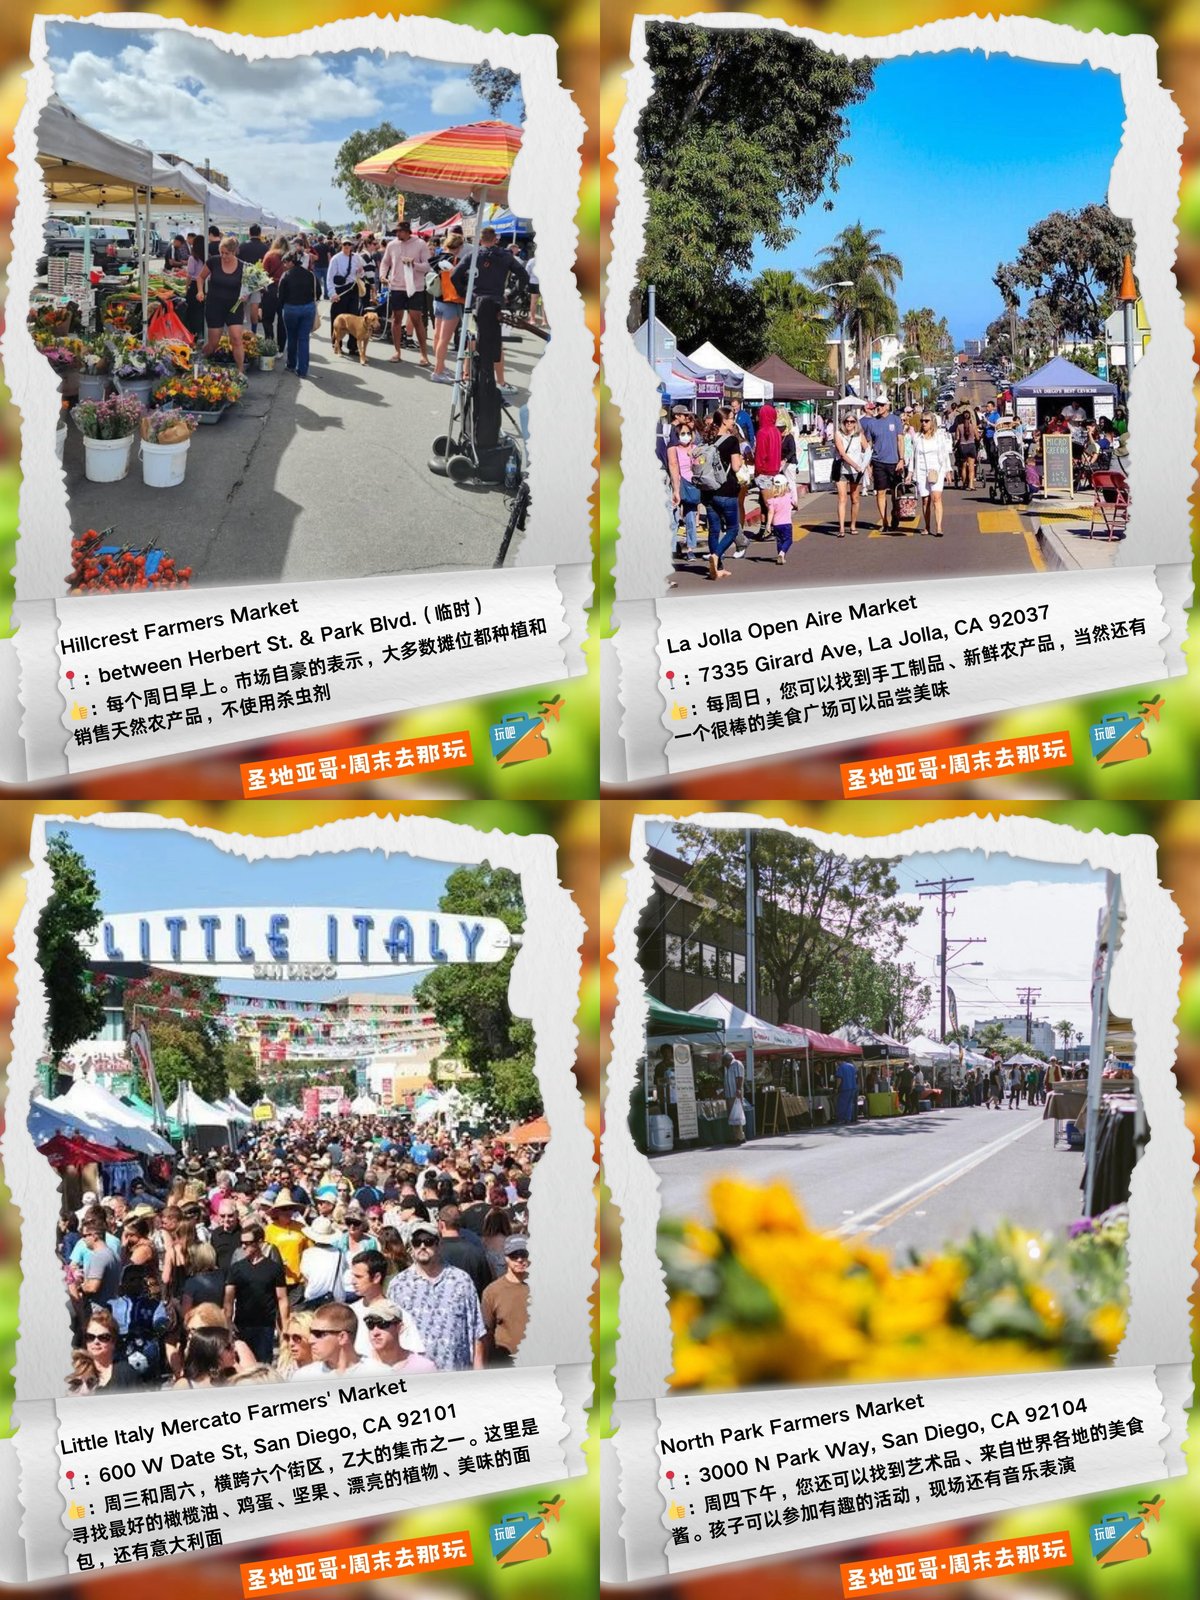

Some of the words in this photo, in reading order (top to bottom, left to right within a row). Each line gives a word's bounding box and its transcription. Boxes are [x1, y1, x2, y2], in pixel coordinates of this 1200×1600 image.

[102, 913, 290, 962] LITTLE
[327, 913, 486, 963] ITALY
[252, 963, 285, 980] SAN
[287, 963, 338, 980] DIEGO
